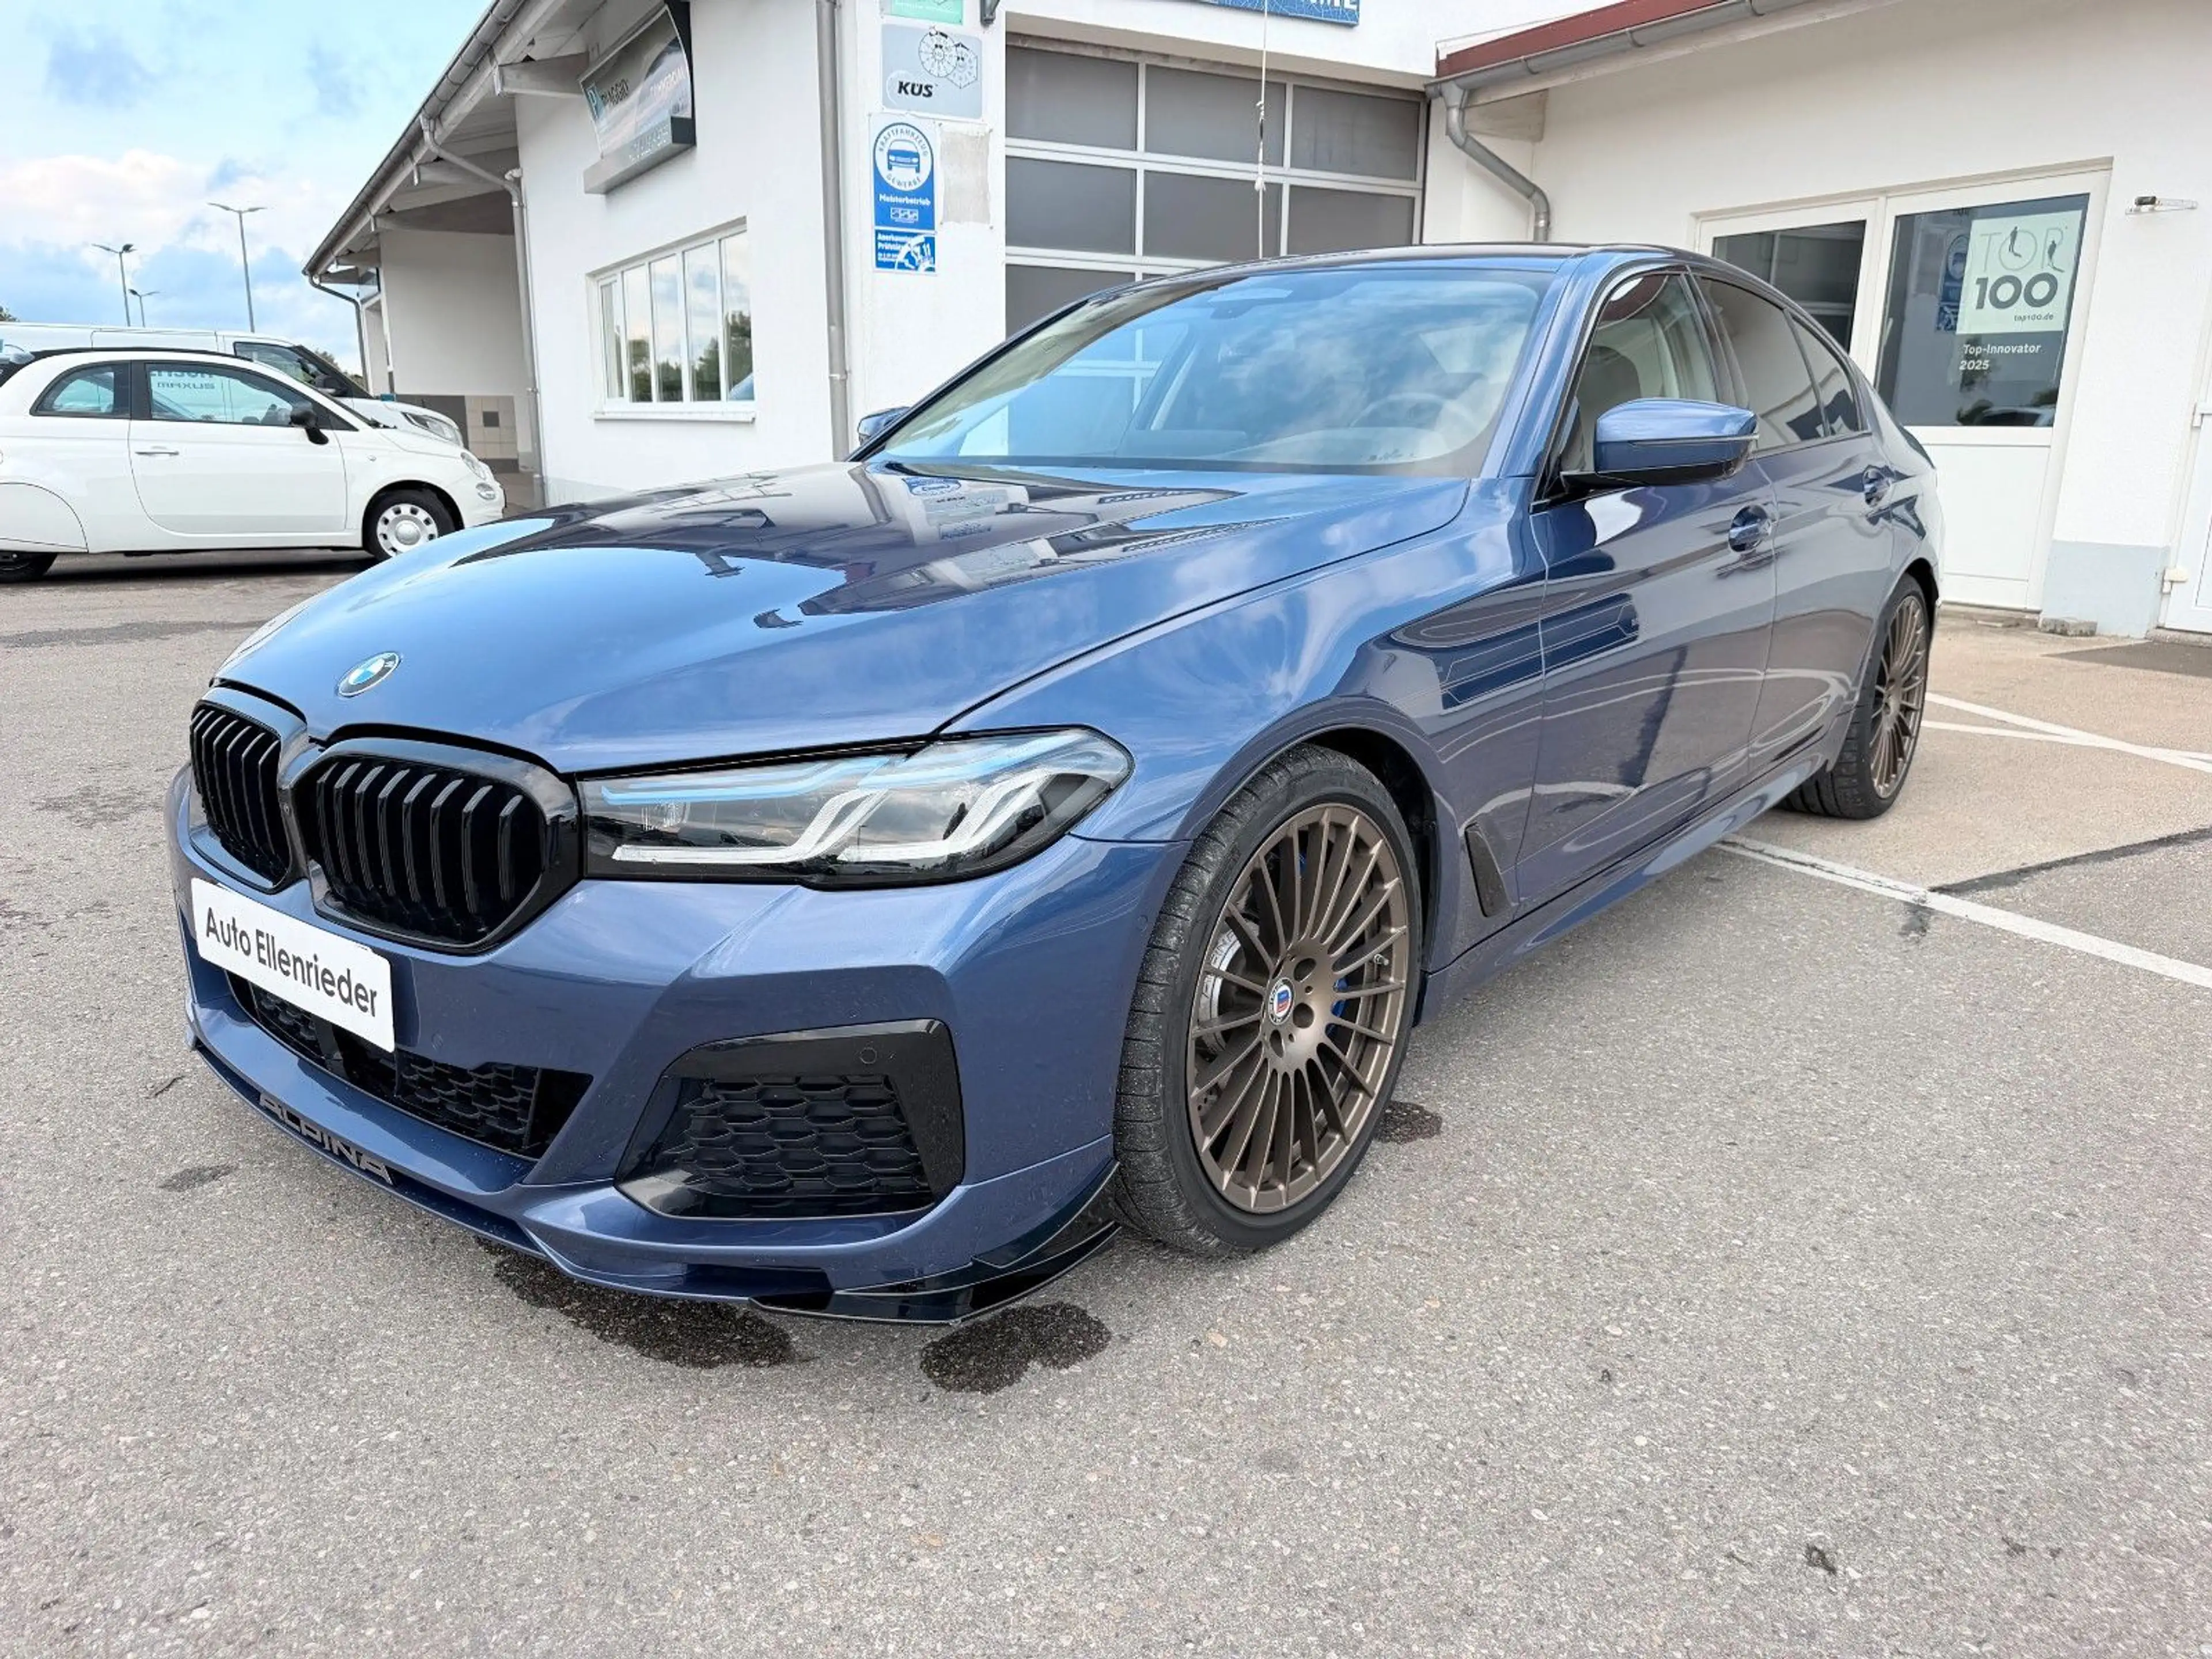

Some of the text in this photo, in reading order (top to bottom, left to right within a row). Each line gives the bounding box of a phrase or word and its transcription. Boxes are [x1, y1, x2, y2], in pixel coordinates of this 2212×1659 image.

[897, 80, 933, 98] KÜS
[1975, 272, 2058, 310] 100
[2014, 313, 2055, 323] top100.de
[1963, 343, 2041, 355] Top-Innovator
[1959, 359, 1990, 370] 2025
[206, 907, 378, 1017] Auto Ellenrieder
